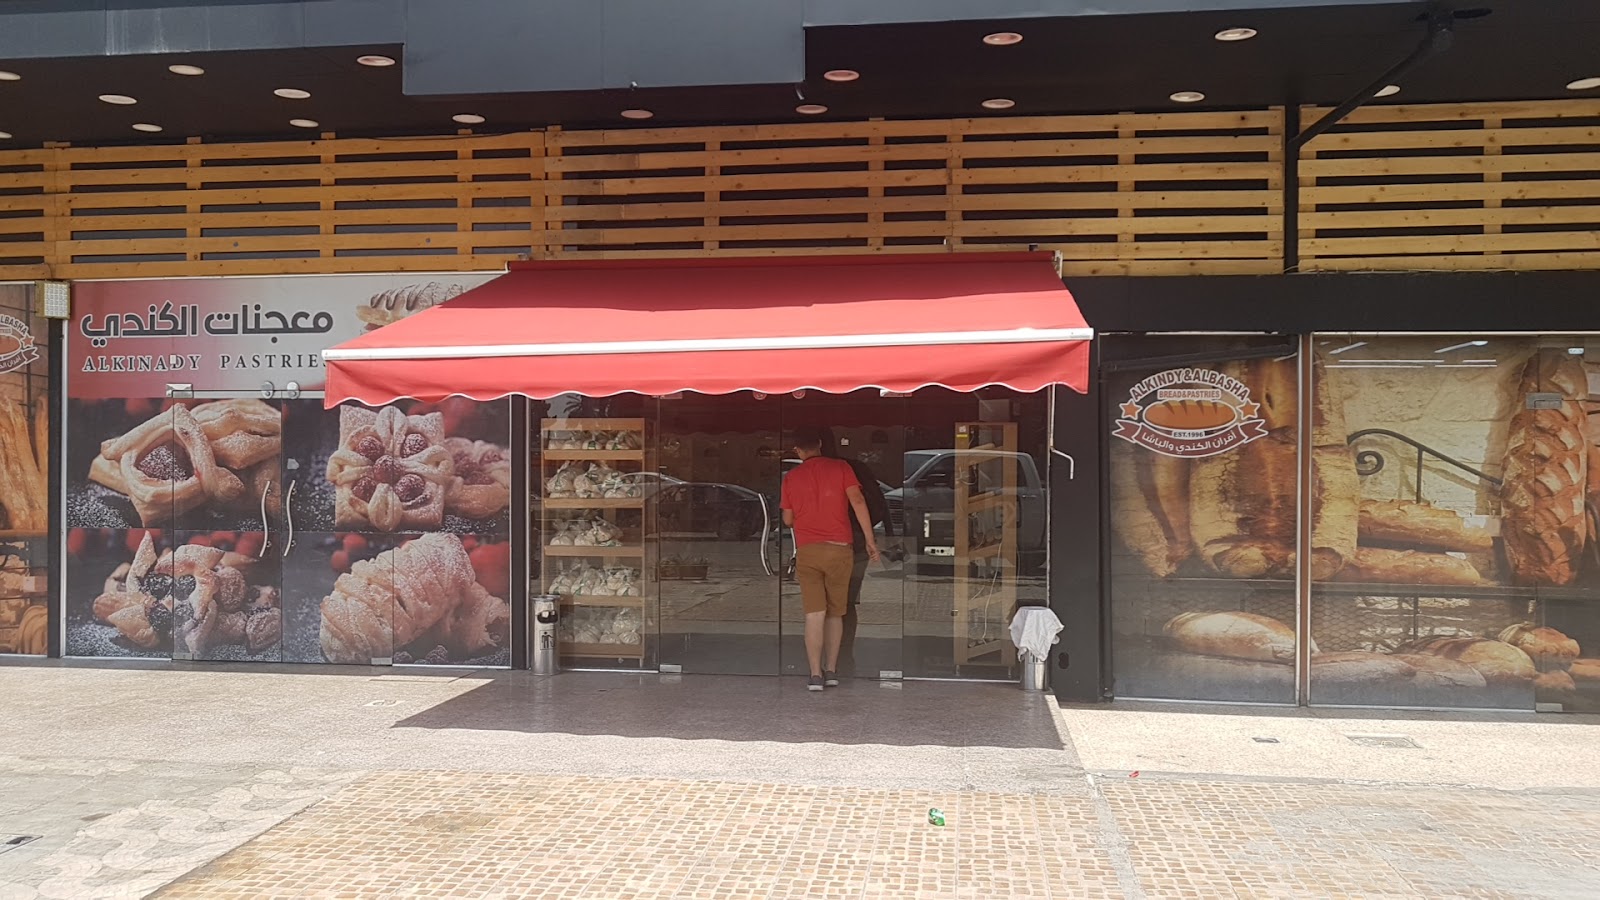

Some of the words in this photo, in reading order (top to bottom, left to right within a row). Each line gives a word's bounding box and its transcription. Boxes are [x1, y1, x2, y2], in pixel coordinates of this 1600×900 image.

[81, 301, 198, 347] الكندي
[204, 303, 333, 344] معجنات
[82, 354, 201, 372] ALKINADY
[220, 354, 326, 369] PASTRIE
[1131, 369, 1249, 401] ALKINDY&ALBASHA
[1158, 390, 1221, 399] BREAD&PASTRIES
[1175, 441, 1211, 454] الكندي
